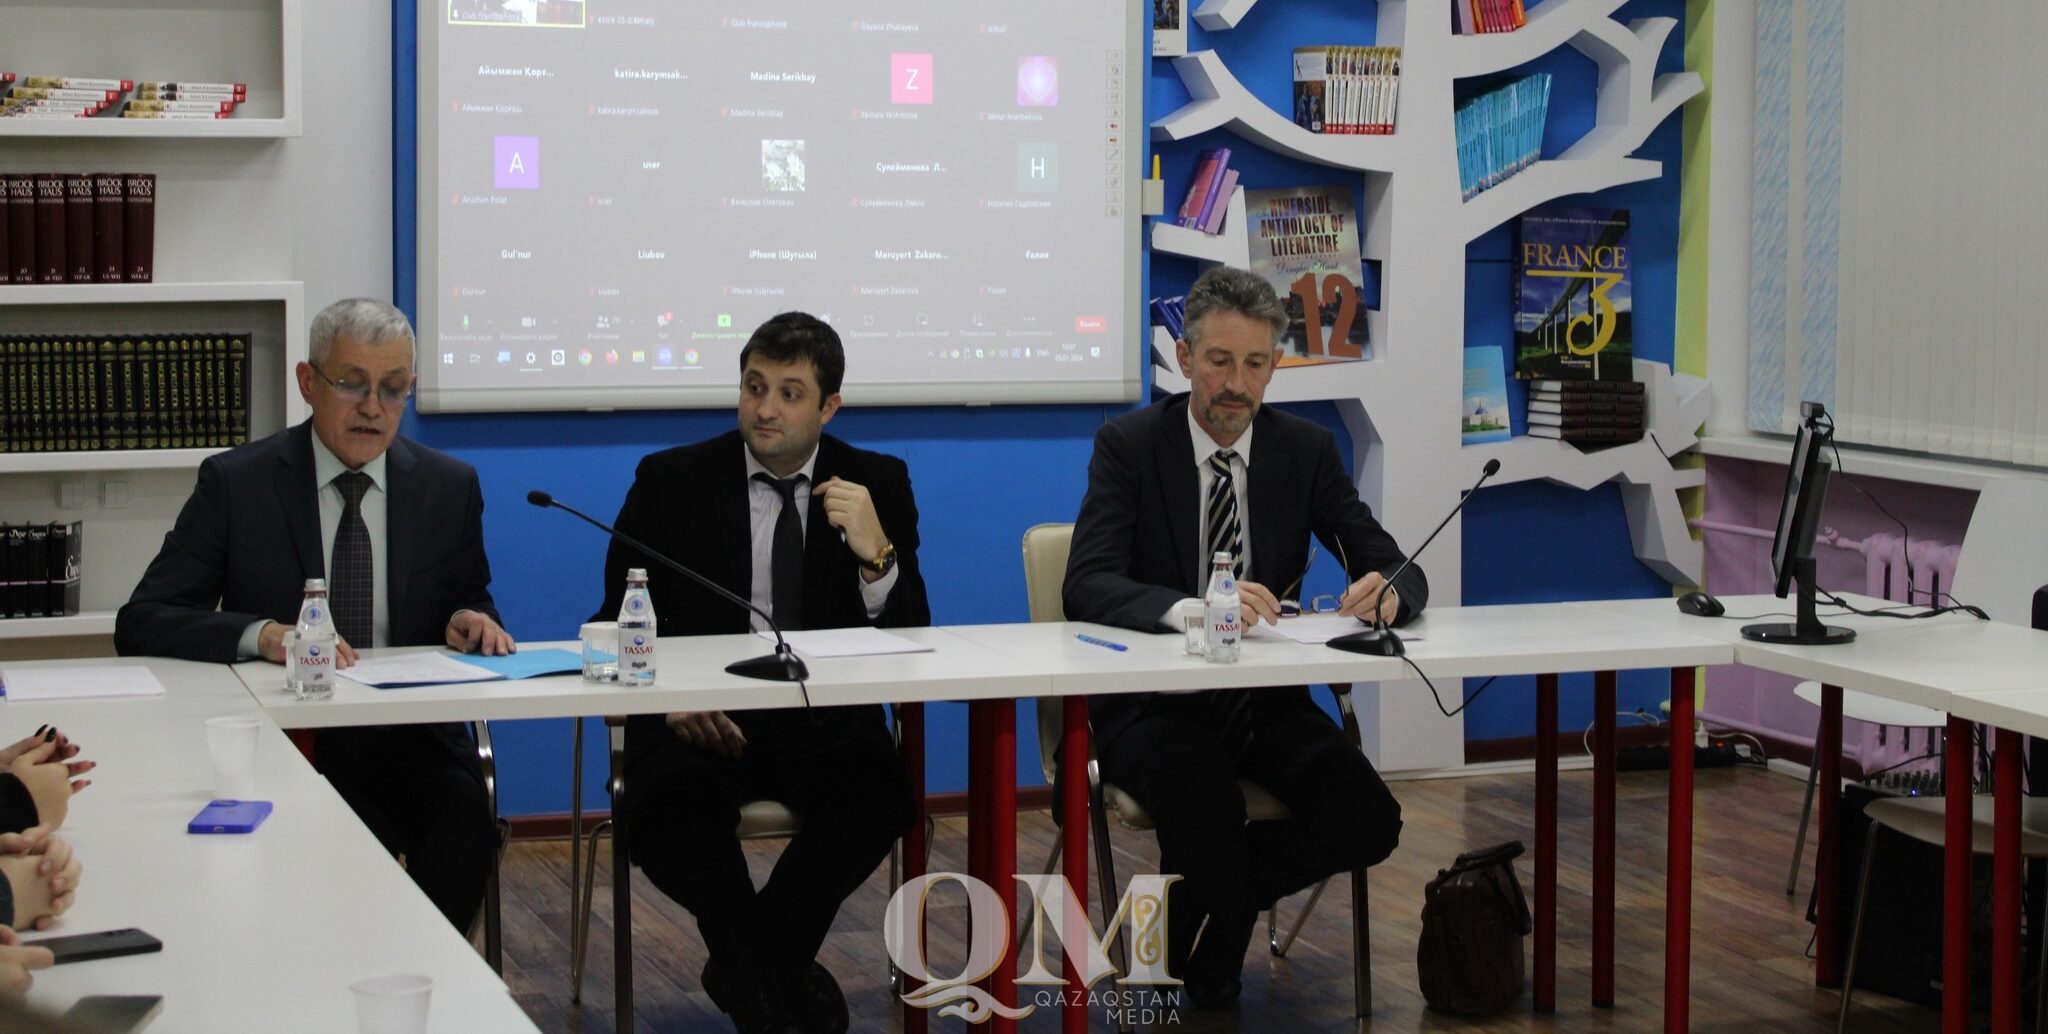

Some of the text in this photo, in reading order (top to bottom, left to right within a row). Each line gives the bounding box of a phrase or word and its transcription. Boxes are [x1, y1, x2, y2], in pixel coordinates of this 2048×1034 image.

[614, 68, 688, 81] katira.karymsak...
[750, 71, 816, 84] Madina Serikbay
[906, 68, 919, 90] Z
[509, 152, 525, 174] A
[643, 161, 660, 170] user
[876, 162, 930, 173] Сулейменова
[9, 180, 34, 188] BROCK
[38, 180, 64, 188] BROCK
[68, 179, 93, 187] BROCK
[97, 178, 122, 187] BROCK
[127, 179, 153, 187] BROCK
[11, 188, 32, 196] HAUS
[40, 188, 62, 196] HAUS
[70, 187, 91, 195] HAUS
[99, 187, 121, 195] HAUS
[129, 187, 151, 195] HAUS
[1268, 196, 1332, 217] RIVERSIDE
[1260, 213, 1344, 238] ANTHOLOGY OF
[1270, 234, 1339, 257] LITERATURE
[501, 249, 531, 259] Gul'nur
[638, 249, 665, 259] Liubov
[749, 250, 777, 259] iPhone
[875, 250, 911, 260] Meruyert
[1521, 243, 1628, 269] FRANCE
[1290, 272, 1362, 358] 12
[624, 646, 654, 655] TASSAY
[299, 656, 331, 666] TASSAY
